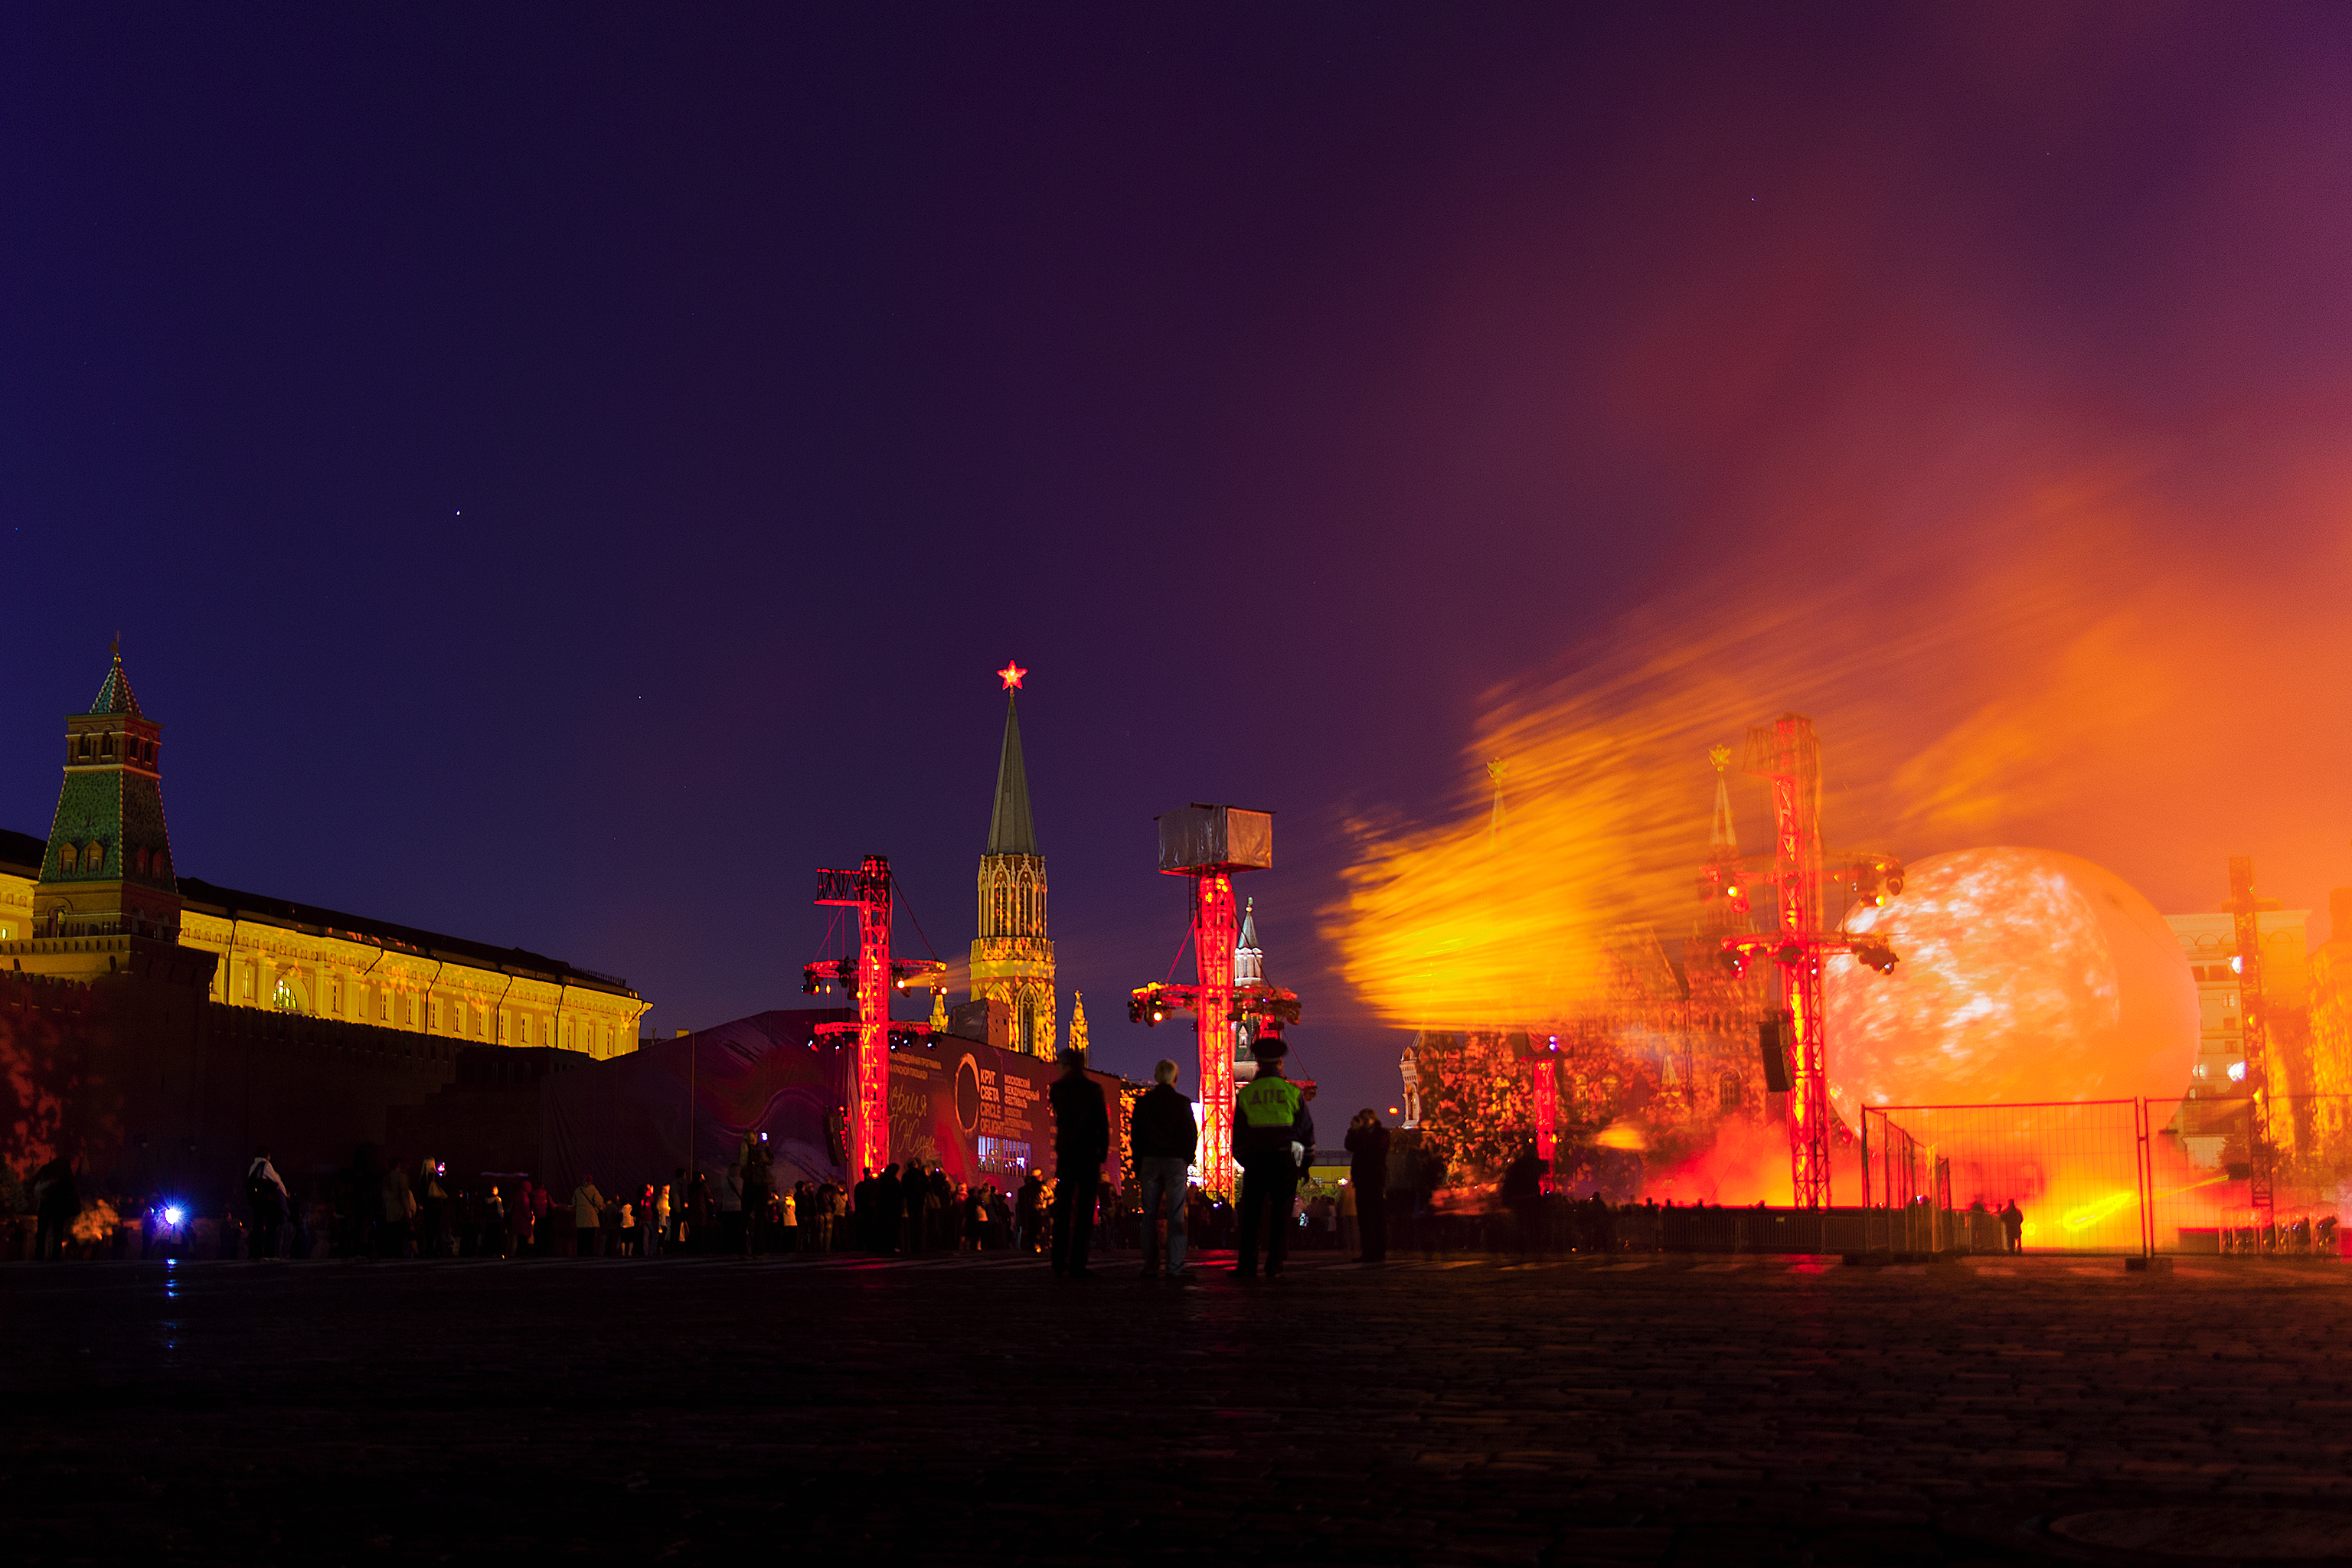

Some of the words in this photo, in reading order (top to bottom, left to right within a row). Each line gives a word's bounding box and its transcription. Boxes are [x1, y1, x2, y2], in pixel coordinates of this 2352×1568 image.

[980, 1068, 996, 1086] КРУГ
[1004, 1074, 1031, 1089] МОСКОВСКИЙ
[980, 1084, 1000, 1103] СВЕТА
[1004, 1084, 1040, 1102] МЕЖДУНАРОДНЫЙ
[1004, 1095, 1027, 1109] ФЕСТИВАЛЬ
[1250, 1089, 1285, 1105] ДПС
[980, 1102, 1001, 1120] CIRCLE
